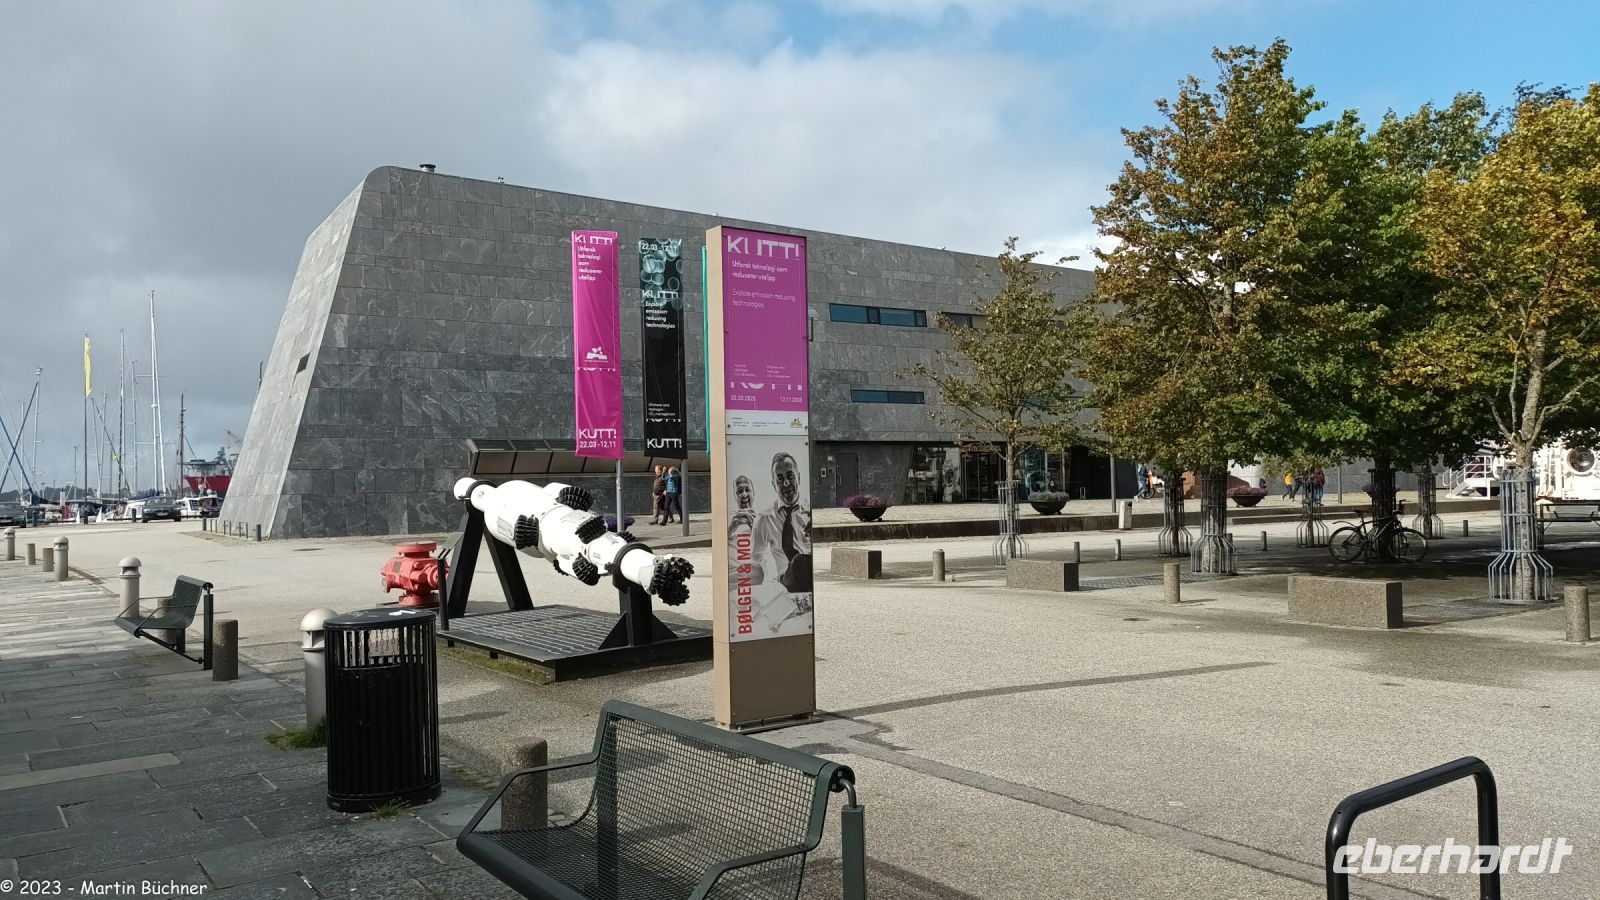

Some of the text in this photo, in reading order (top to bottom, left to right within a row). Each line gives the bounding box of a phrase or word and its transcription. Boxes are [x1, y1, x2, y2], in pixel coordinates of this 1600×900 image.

[752, 263, 776, 273] teknologi
[646, 315, 667, 323] reducing
[578, 428, 617, 439] KUTT!
[646, 438, 682, 449] KUTT!
[736, 533, 752, 634] BØLGEN & MOI
